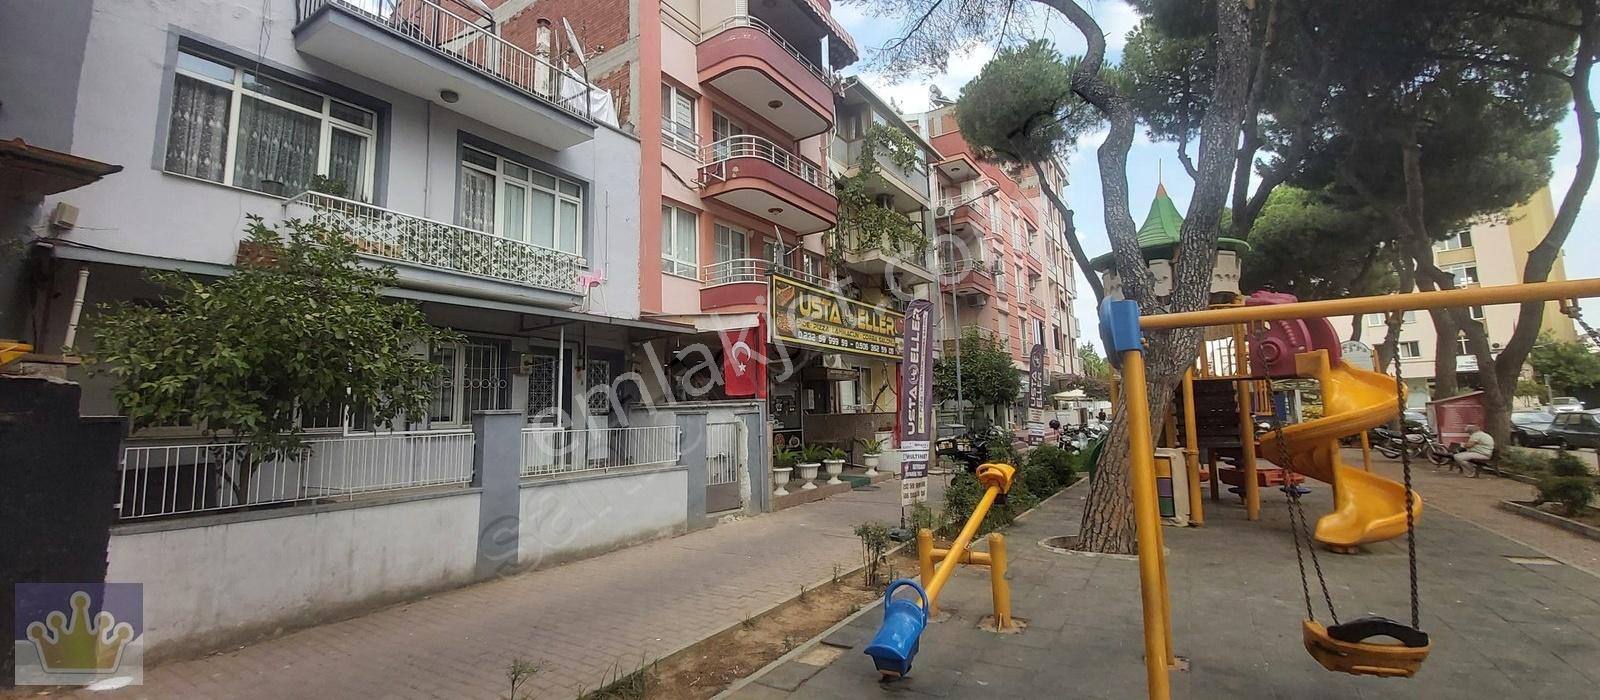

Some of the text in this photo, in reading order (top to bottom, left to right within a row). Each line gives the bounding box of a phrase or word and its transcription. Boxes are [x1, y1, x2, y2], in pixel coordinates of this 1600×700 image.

[799, 291, 842, 324] USTA
[857, 308, 895, 336] ELLER
[910, 307, 921, 363] ELLER
[908, 385, 918, 435] USTA
